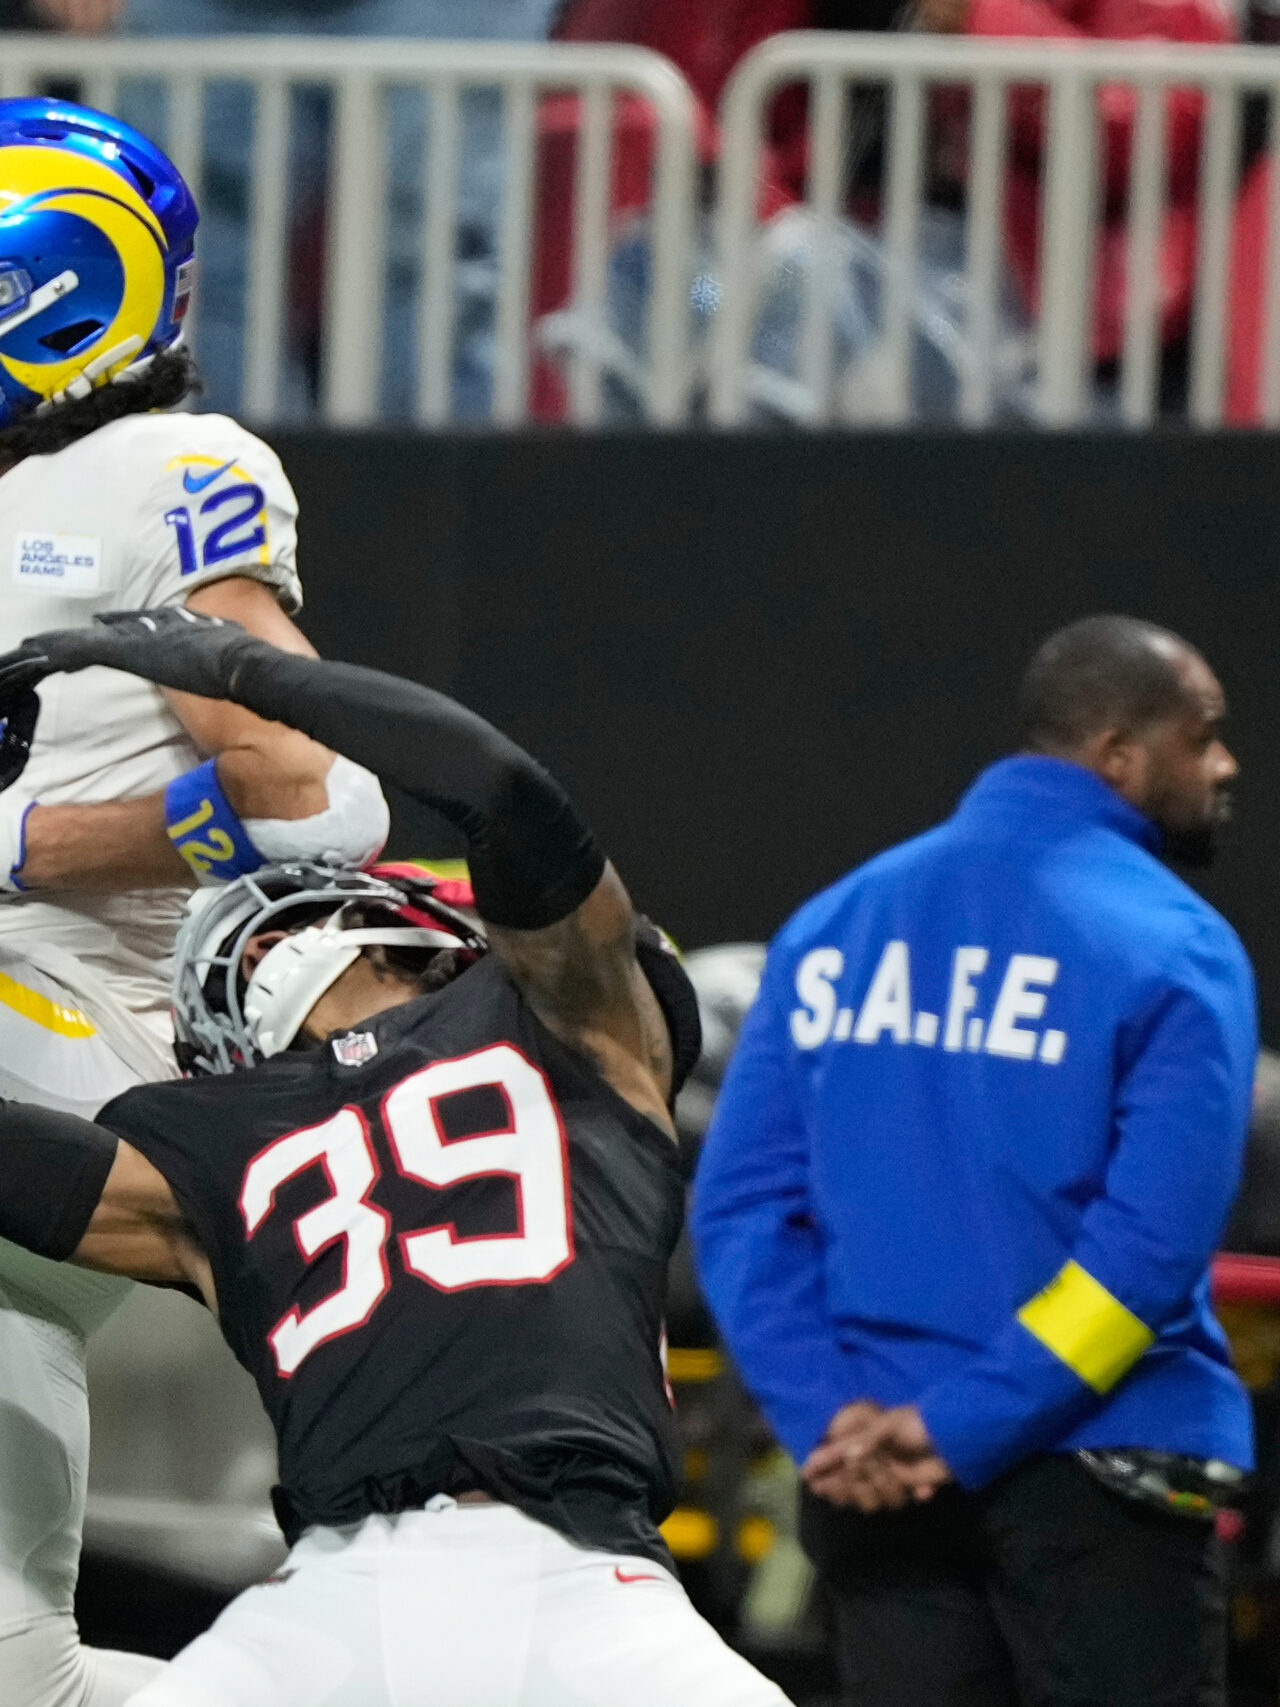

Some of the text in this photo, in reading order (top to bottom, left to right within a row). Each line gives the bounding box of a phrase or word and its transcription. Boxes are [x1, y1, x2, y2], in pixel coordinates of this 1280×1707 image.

[21, 553, 95, 567] ANGELES
[22, 540, 53, 552] LOS
[164, 482, 266, 576] 12
[20, 565, 65, 577] RAMS
[167, 798, 235, 871] 12
[790, 939, 1066, 1064] S.A.F.E.
[238, 1040, 575, 1378] 39
